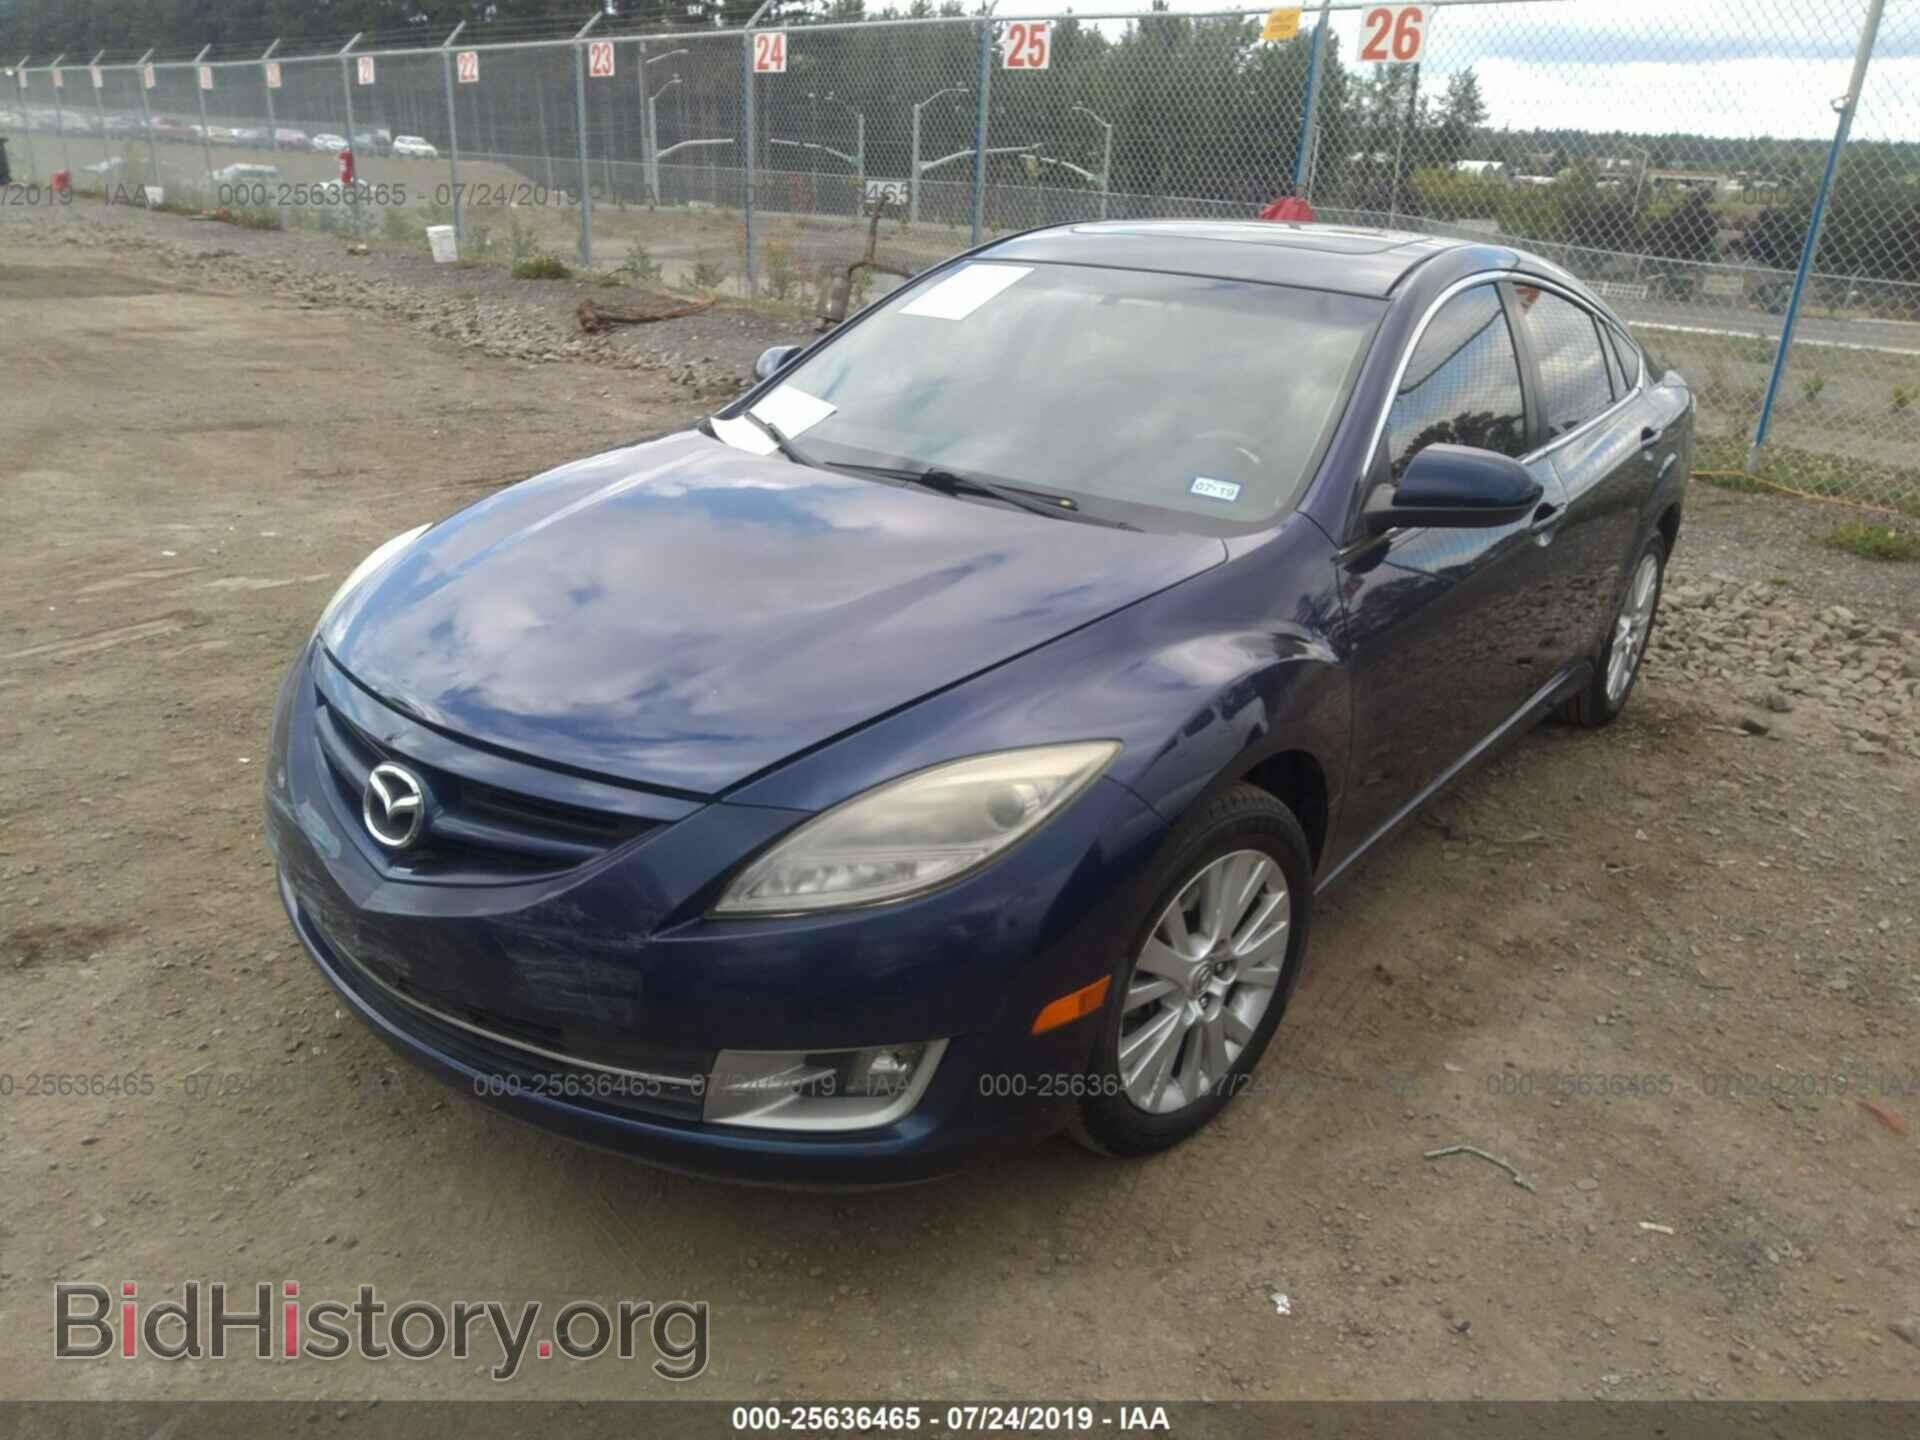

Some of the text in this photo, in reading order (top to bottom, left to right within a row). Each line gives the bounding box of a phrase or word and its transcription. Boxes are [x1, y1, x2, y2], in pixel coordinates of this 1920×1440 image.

[755, 33, 783, 70] 24
[1007, 24, 1046, 66] 25
[1361, 7, 1423, 61] 26
[458, 52, 476, 81] 22
[591, 42, 612, 75] 23
